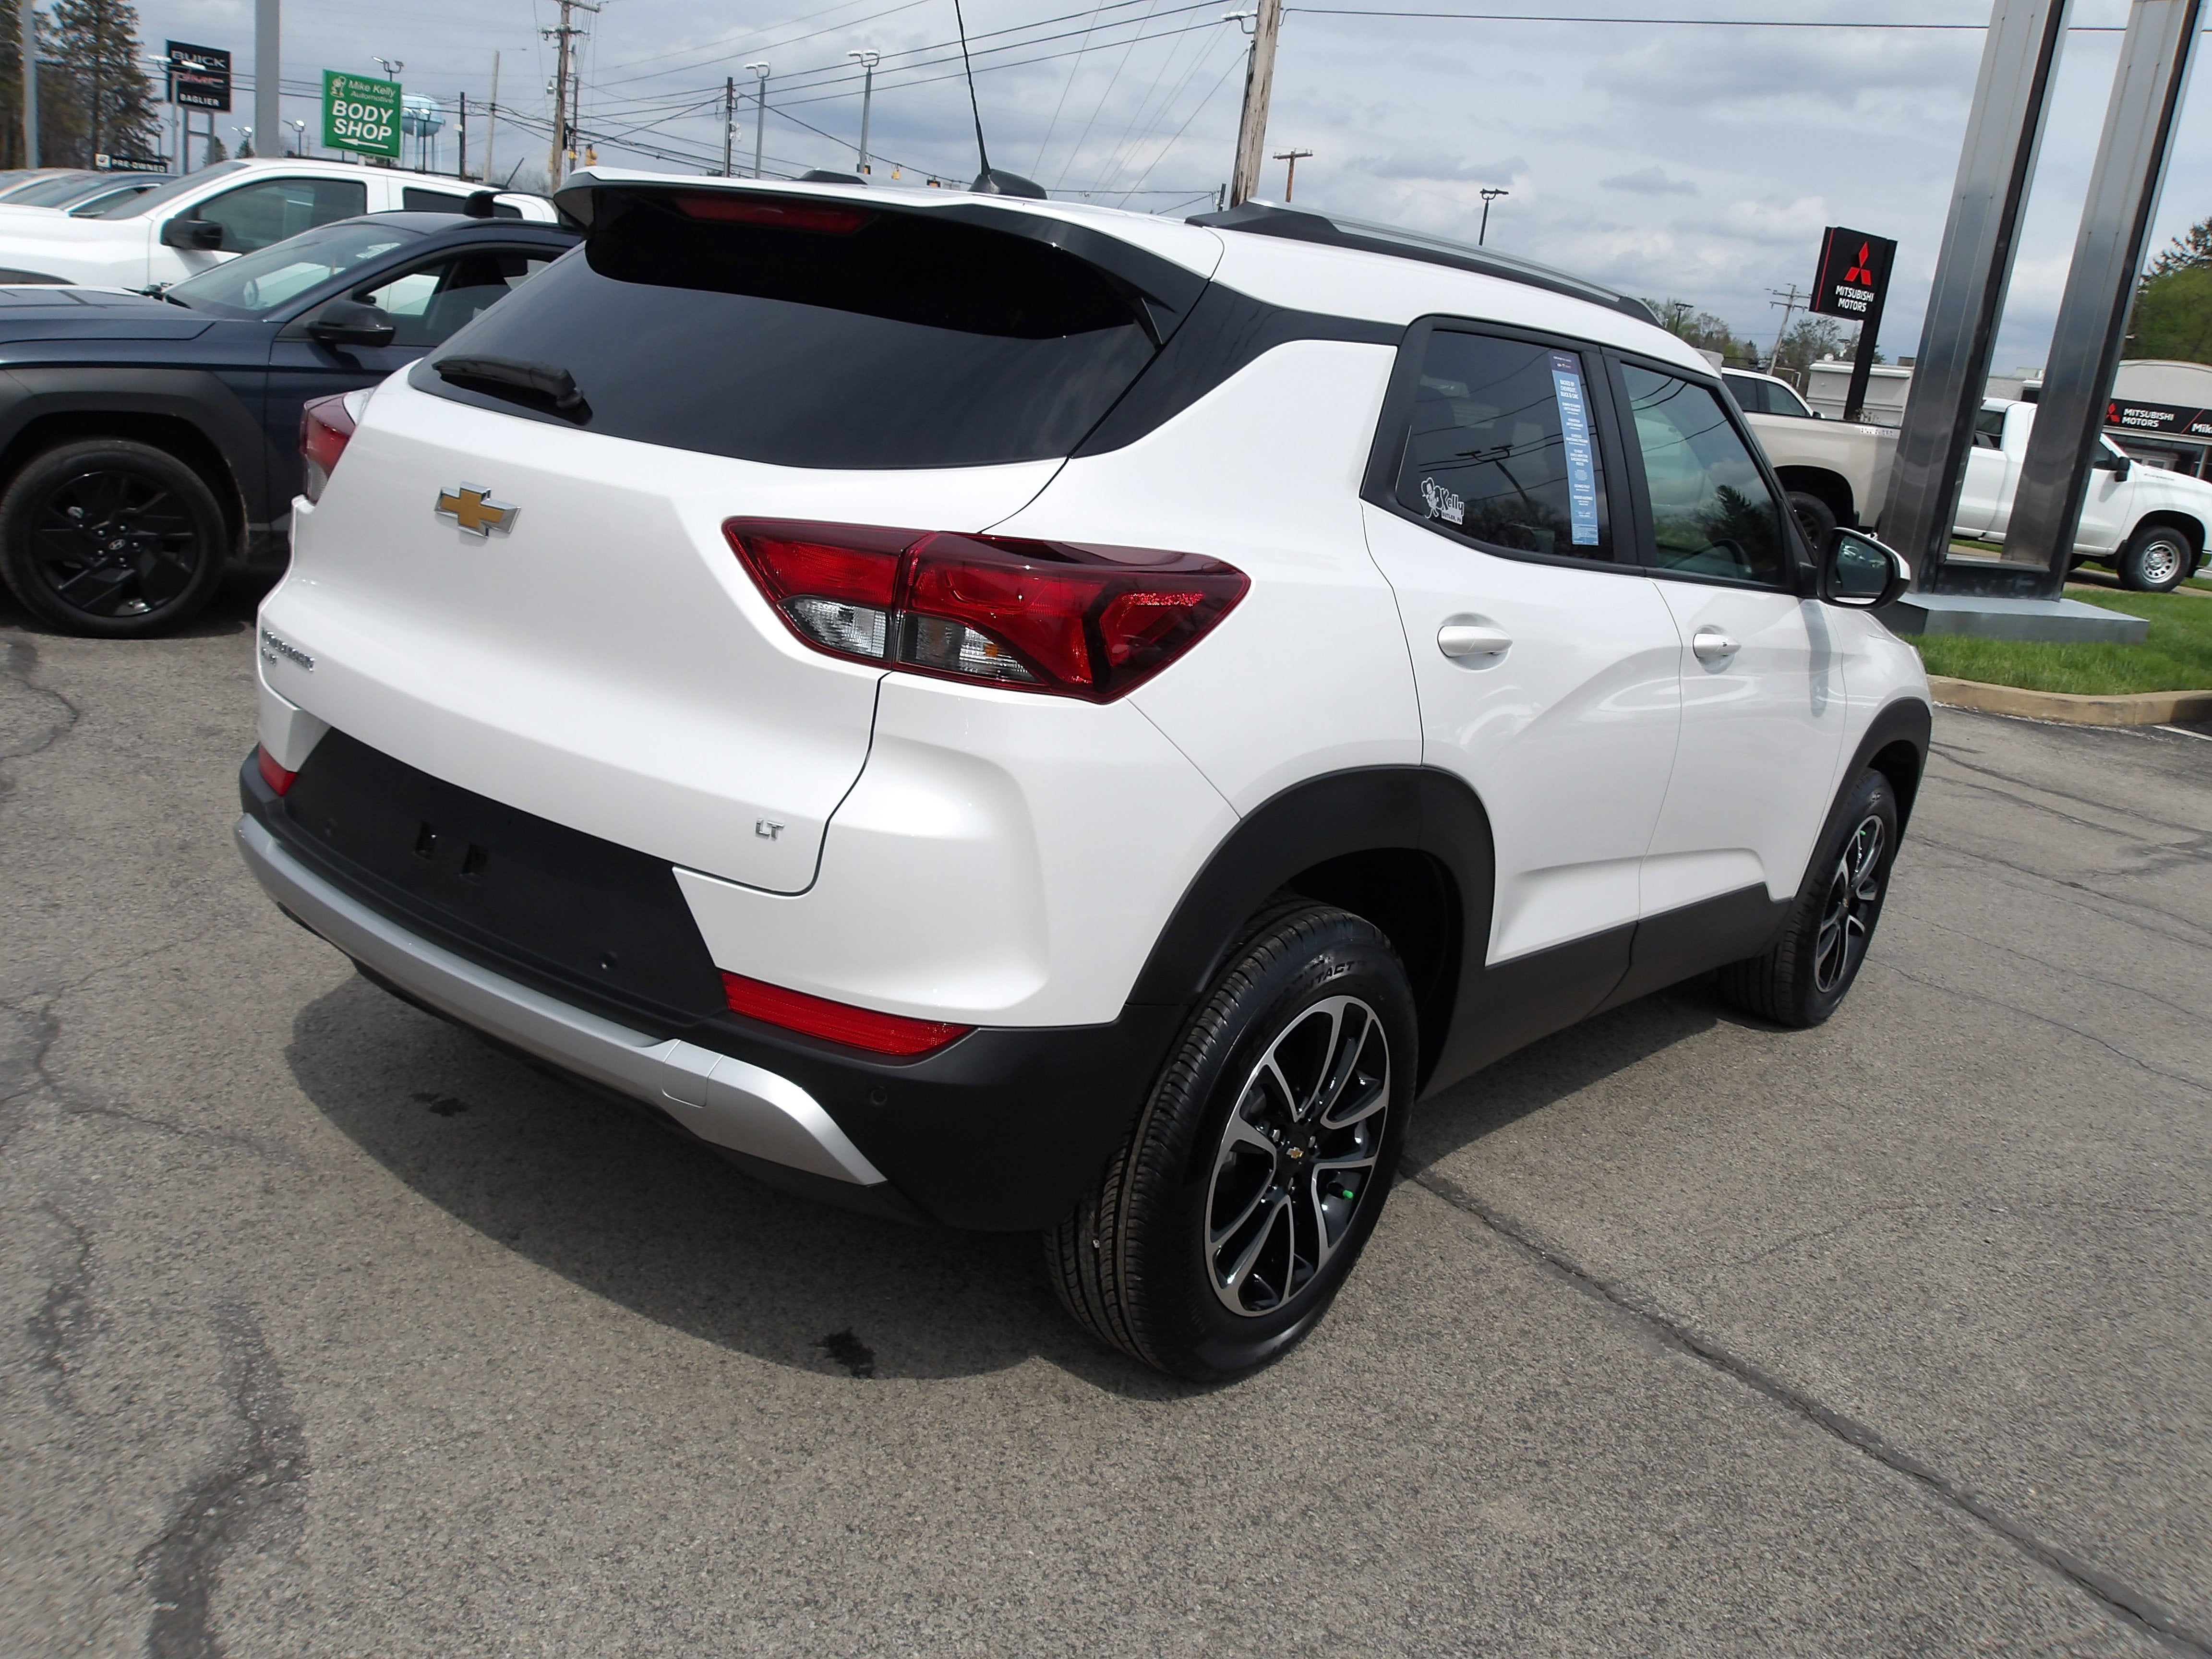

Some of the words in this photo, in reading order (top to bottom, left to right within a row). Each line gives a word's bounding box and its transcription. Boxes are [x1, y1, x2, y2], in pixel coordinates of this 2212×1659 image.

[171, 49, 226, 69] BUICK
[349, 80, 371, 92] Mike
[373, 84, 396, 98] Kelly
[350, 90, 394, 104] Automotive
[180, 93, 220, 107] BAGLIER
[332, 99, 394, 124] BODY
[333, 118, 392, 141] SHOP
[111, 158, 166, 173] PRE-OWNED
[1835, 285, 1875, 302] MITSUBISHI
[1838, 298, 1867, 312] MOTORS
[2122, 417, 2160, 427] MOTORS
[2123, 408, 2174, 421] MITSUBISHI
[2191, 423, 2212, 434] Mik
[1440, 488, 1464, 517] Kelly
[756, 818, 785, 839] LT
